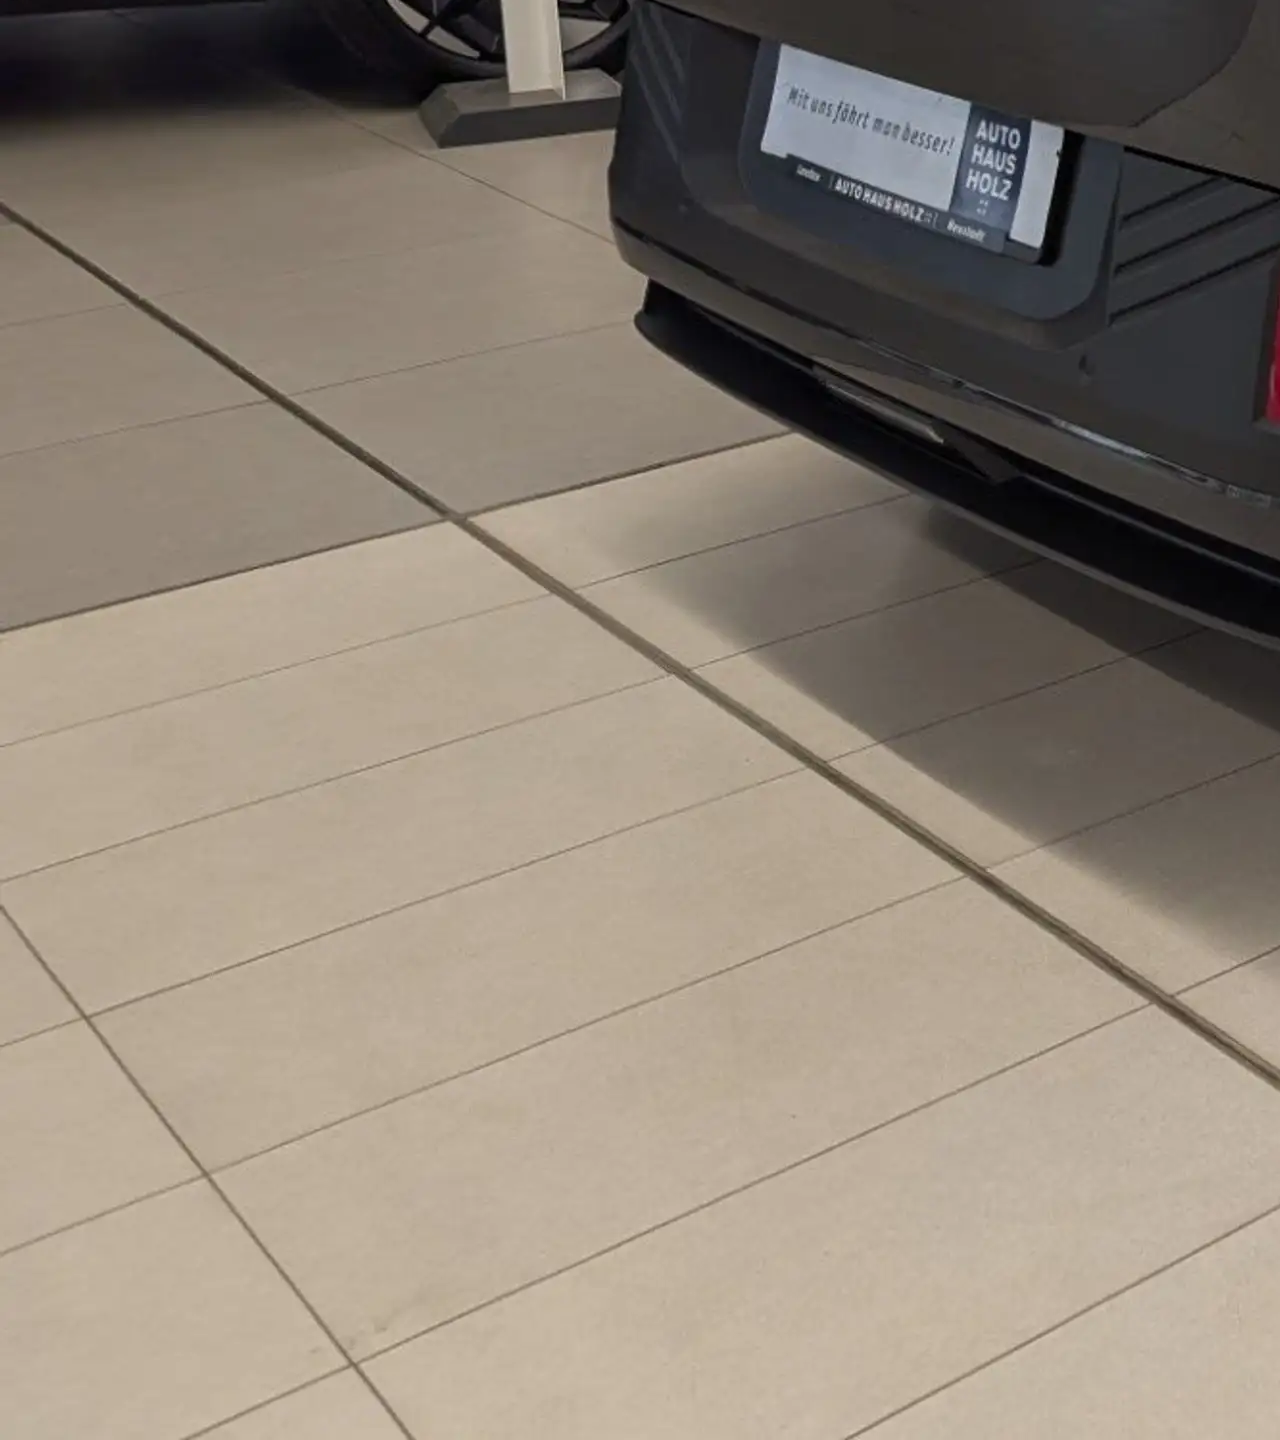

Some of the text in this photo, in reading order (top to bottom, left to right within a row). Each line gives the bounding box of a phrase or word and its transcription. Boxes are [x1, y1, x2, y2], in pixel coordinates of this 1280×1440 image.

[787, 86, 956, 157] Mit uns fährt man besser!
[976, 118, 1021, 150] AUTO
[970, 142, 1018, 175] HAUS
[834, 177, 924, 223] AUTO HAUS HOLZ
[965, 168, 1013, 201] HOLZ
